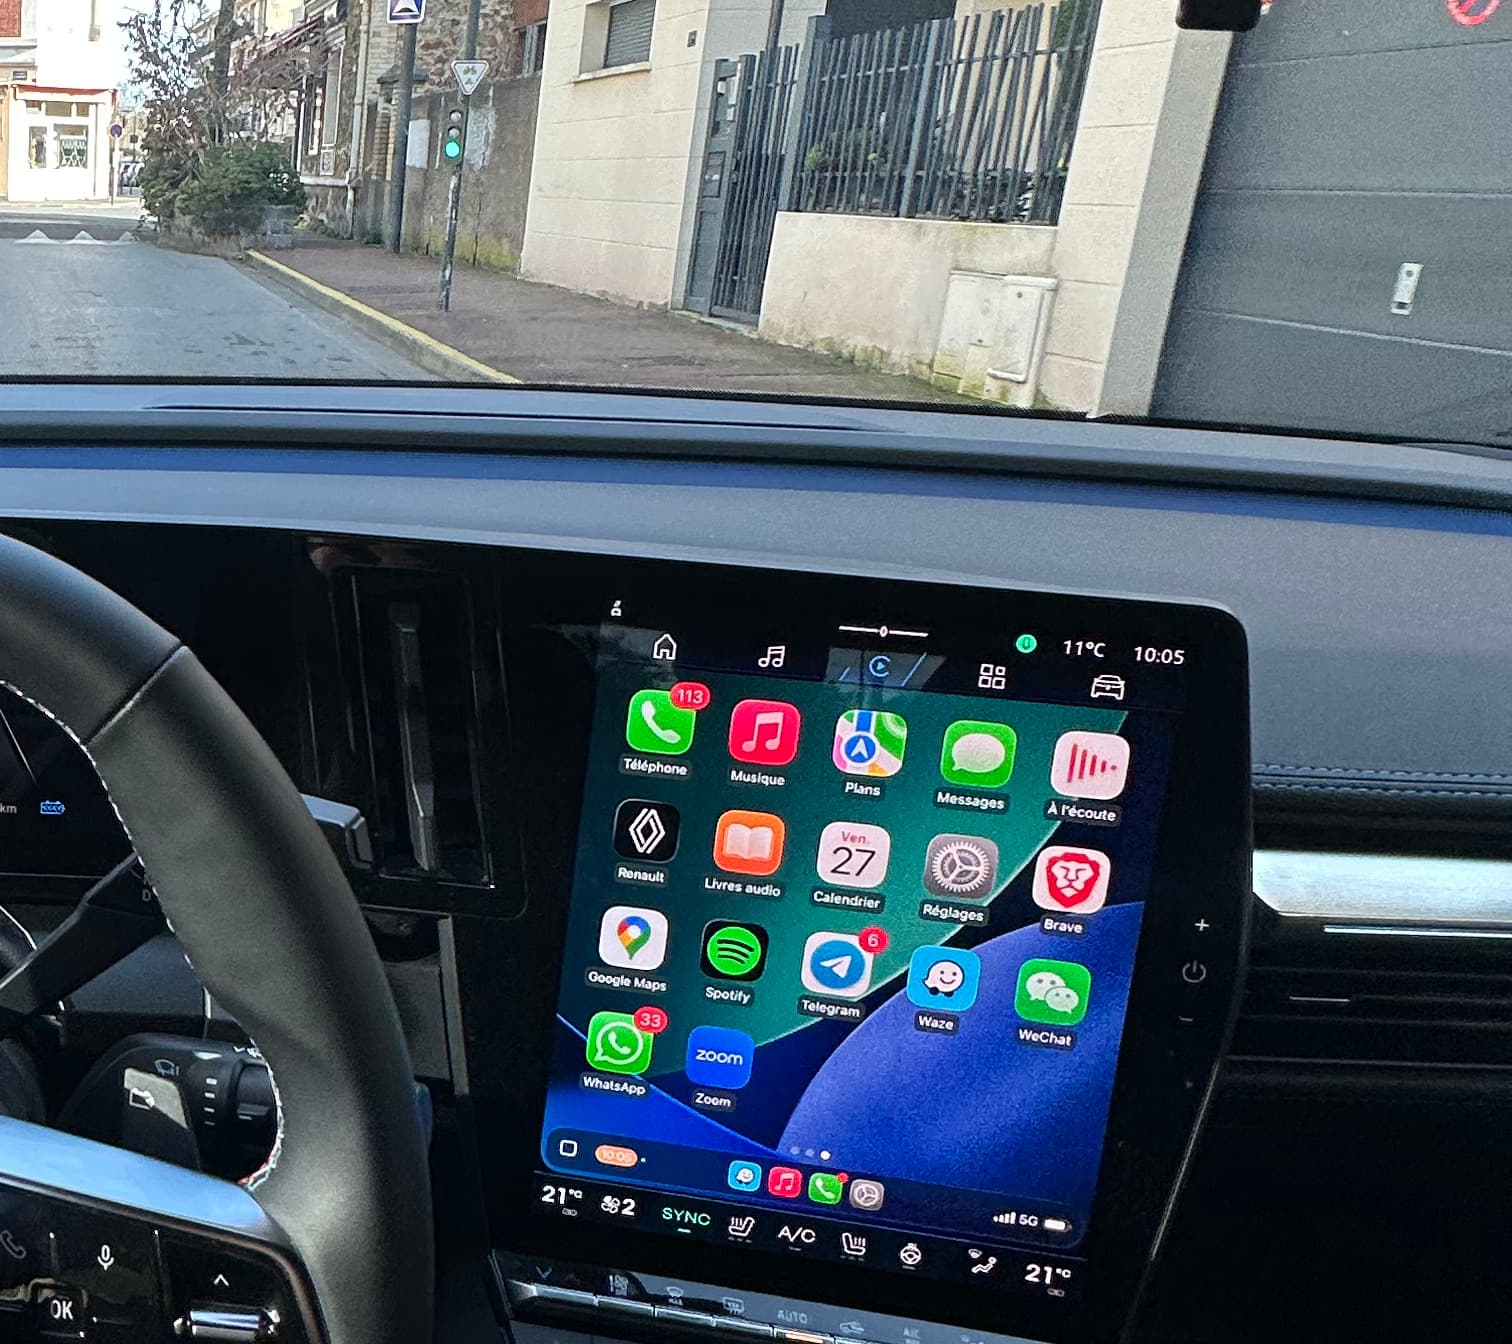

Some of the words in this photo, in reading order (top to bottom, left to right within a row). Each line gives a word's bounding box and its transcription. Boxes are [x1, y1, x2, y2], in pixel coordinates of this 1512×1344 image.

[1063, 640, 1106, 657] 11°C
[1134, 646, 1185, 664] 10:05
[678, 689, 704, 704] 113
[623, 758, 688, 776] Téléphone
[730, 769, 786, 787] Musique
[844, 781, 881, 797] Plans
[0, 802, 17, 814] km
[937, 791, 1005, 811] Messages
[1047, 801, 1057, 815] À
[830, 846, 876, 877] 27
[617, 867, 665, 883] Renault
[704, 877, 742, 893] Livres
[745, 884, 781, 898] audio
[813, 890, 881, 910] Calendrier
[922, 903, 984, 922] Réglages
[1043, 918, 1083, 934] Brave
[867, 934, 879, 947] 6
[588, 970, 631, 988] Google
[634, 977, 667, 992] Maps
[705, 987, 751, 1005] Spotify
[801, 999, 861, 1018] Telegram
[639, 1012, 661, 1028] 33
[918, 1015, 954, 1031] Waze
[1018, 1028, 1072, 1046] WeChat
[695, 1049, 743, 1066] zoom
[583, 1076, 646, 1096] WhatsApp
[695, 1092, 731, 1107] Zoom
[621, 1198, 636, 1216] 2
[662, 1207, 711, 1226] SYNC
[1019, 1214, 1038, 1227] 5G
[777, 1225, 816, 1243] A/C
[1024, 1263, 1071, 1285] 21°C
[50, 1300, 73, 1320] OK
[777, 1309, 808, 1324] AUTO
